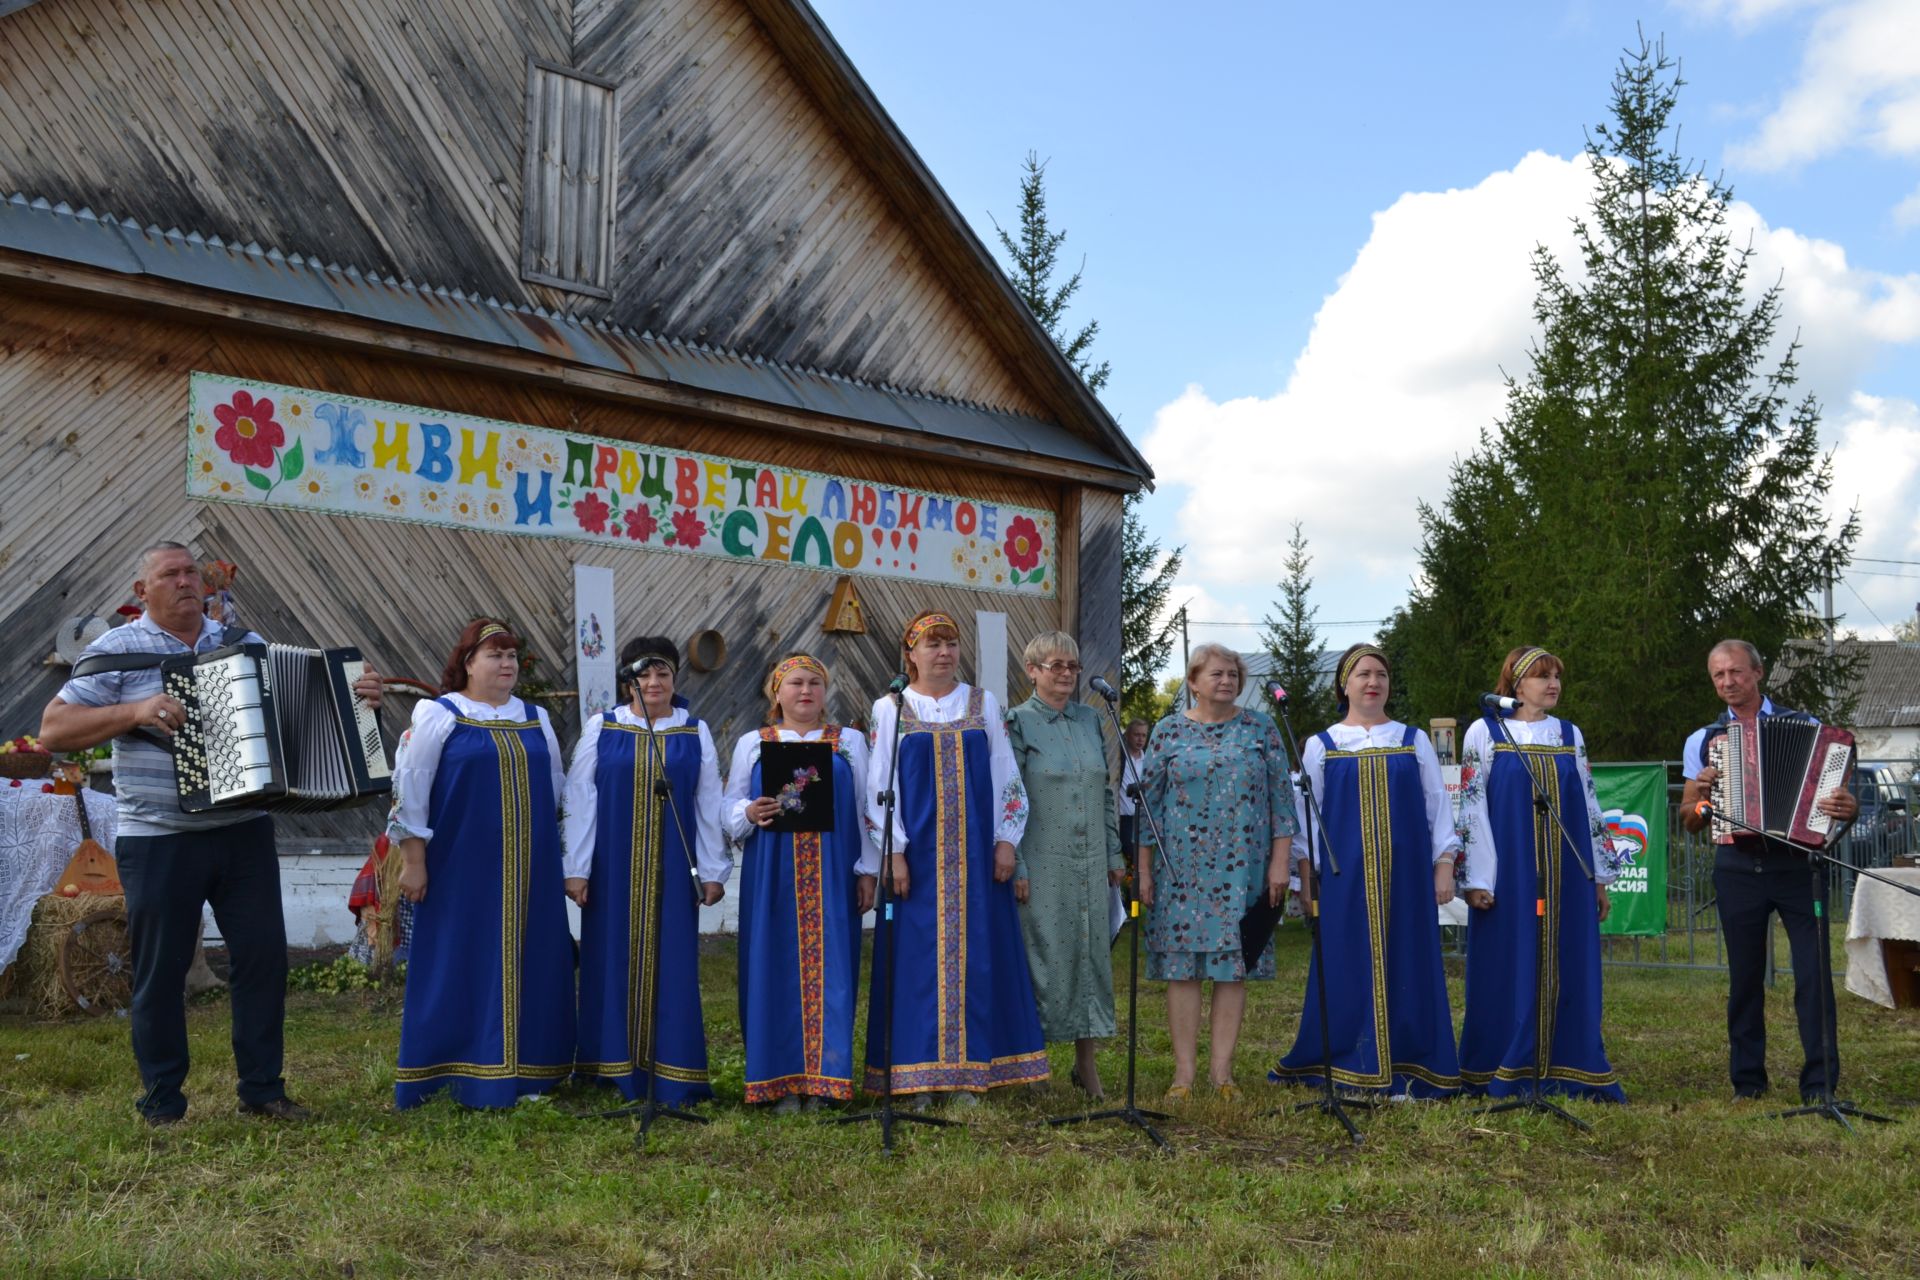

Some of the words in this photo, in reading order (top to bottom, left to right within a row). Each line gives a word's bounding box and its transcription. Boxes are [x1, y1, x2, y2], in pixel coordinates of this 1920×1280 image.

[313, 402, 504, 490] ЖИВИ
[513, 470, 554, 526] И
[562, 438, 808, 517] ПРОЦВЕТАЙ
[820, 479, 998, 542] ЛЮБИМОЕ
[1619, 866, 1648, 879] НАЯ
[1604, 880, 1648, 893] ССИЯ
